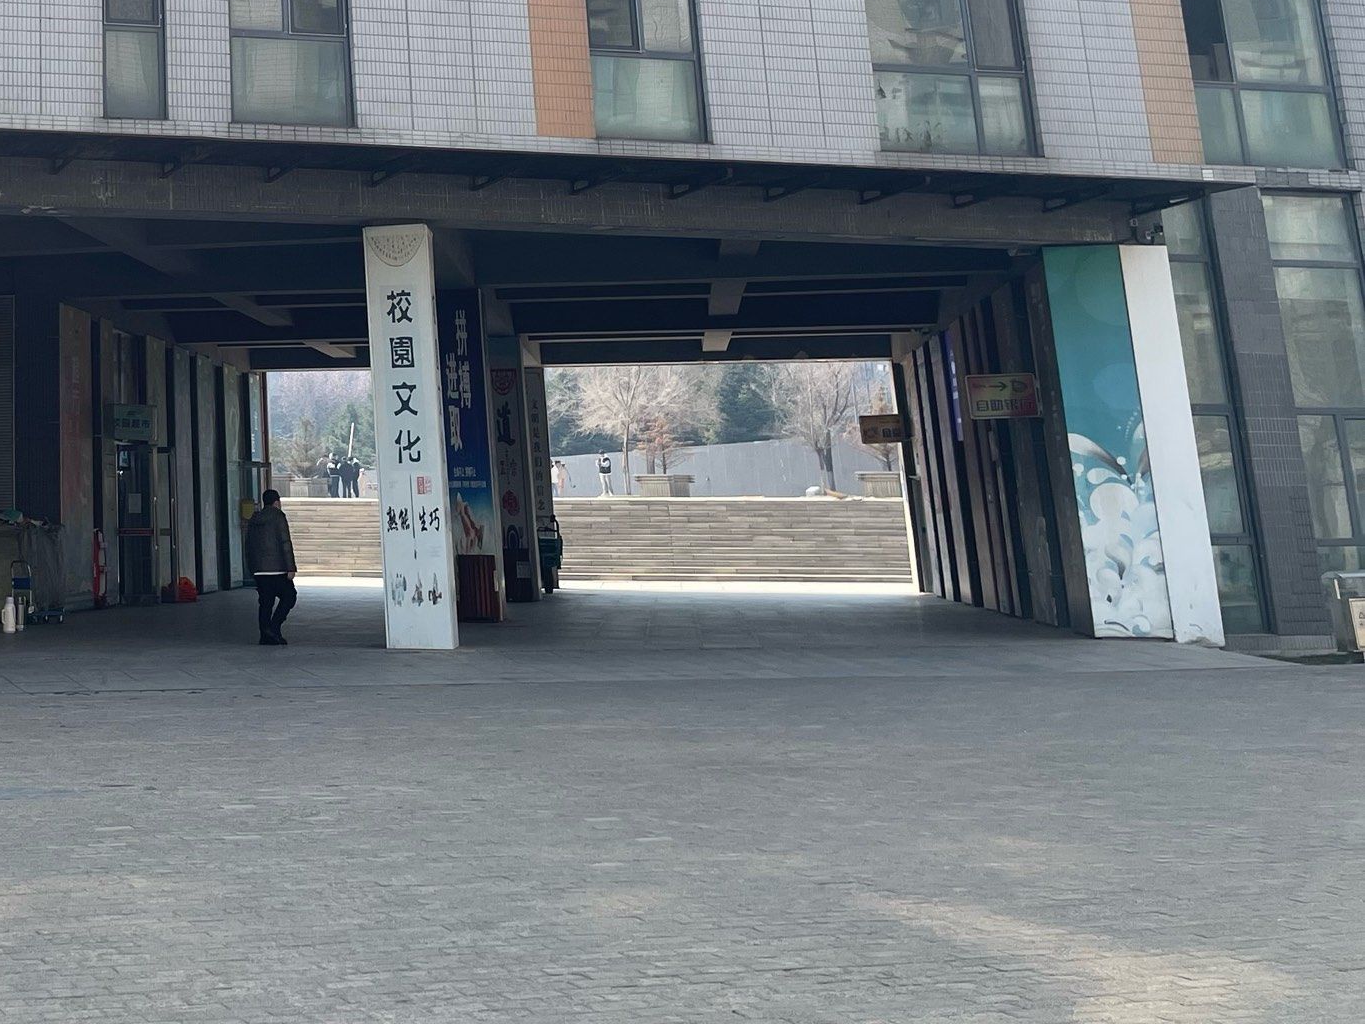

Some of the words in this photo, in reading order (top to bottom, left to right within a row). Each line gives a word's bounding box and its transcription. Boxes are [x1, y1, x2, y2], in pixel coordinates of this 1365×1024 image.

[387, 290, 421, 464] 校園文化
[454, 309, 472, 410] 拼搏
[496, 402, 517, 449] 道
[976, 398, 1036, 413] 自助银行
